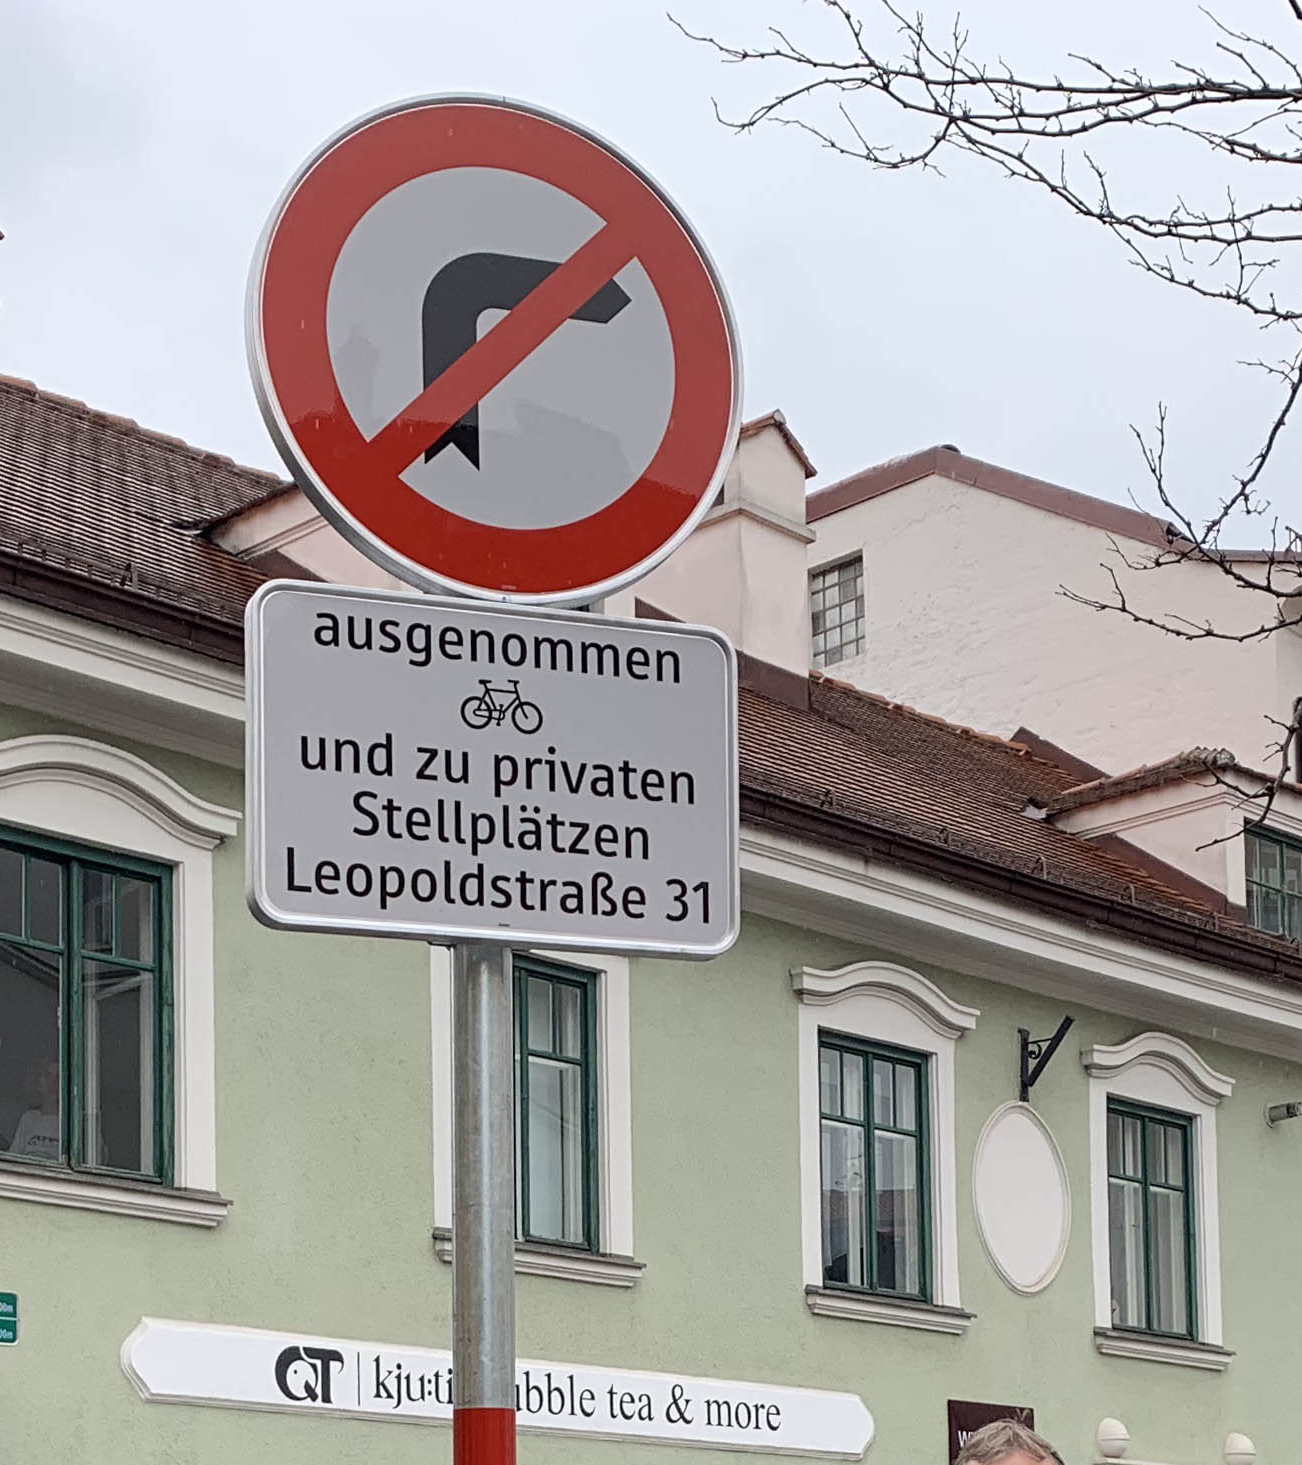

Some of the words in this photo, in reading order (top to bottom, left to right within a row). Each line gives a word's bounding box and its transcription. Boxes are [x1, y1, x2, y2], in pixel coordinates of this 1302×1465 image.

[313, 612, 682, 684] ausgenommen
[300, 733, 394, 777] und
[416, 745, 470, 784] zu
[493, 746, 696, 806] privaten
[352, 790, 651, 860] Stellplätzen
[285, 846, 647, 919] Leopoldstraße
[665, 878, 712, 925] 31
[274, 1345, 345, 1404] QT
[515, 1370, 597, 1418] bble
[607, 1383, 655, 1422] tea
[664, 1383, 694, 1425] &
[703, 1397, 782, 1432] more
